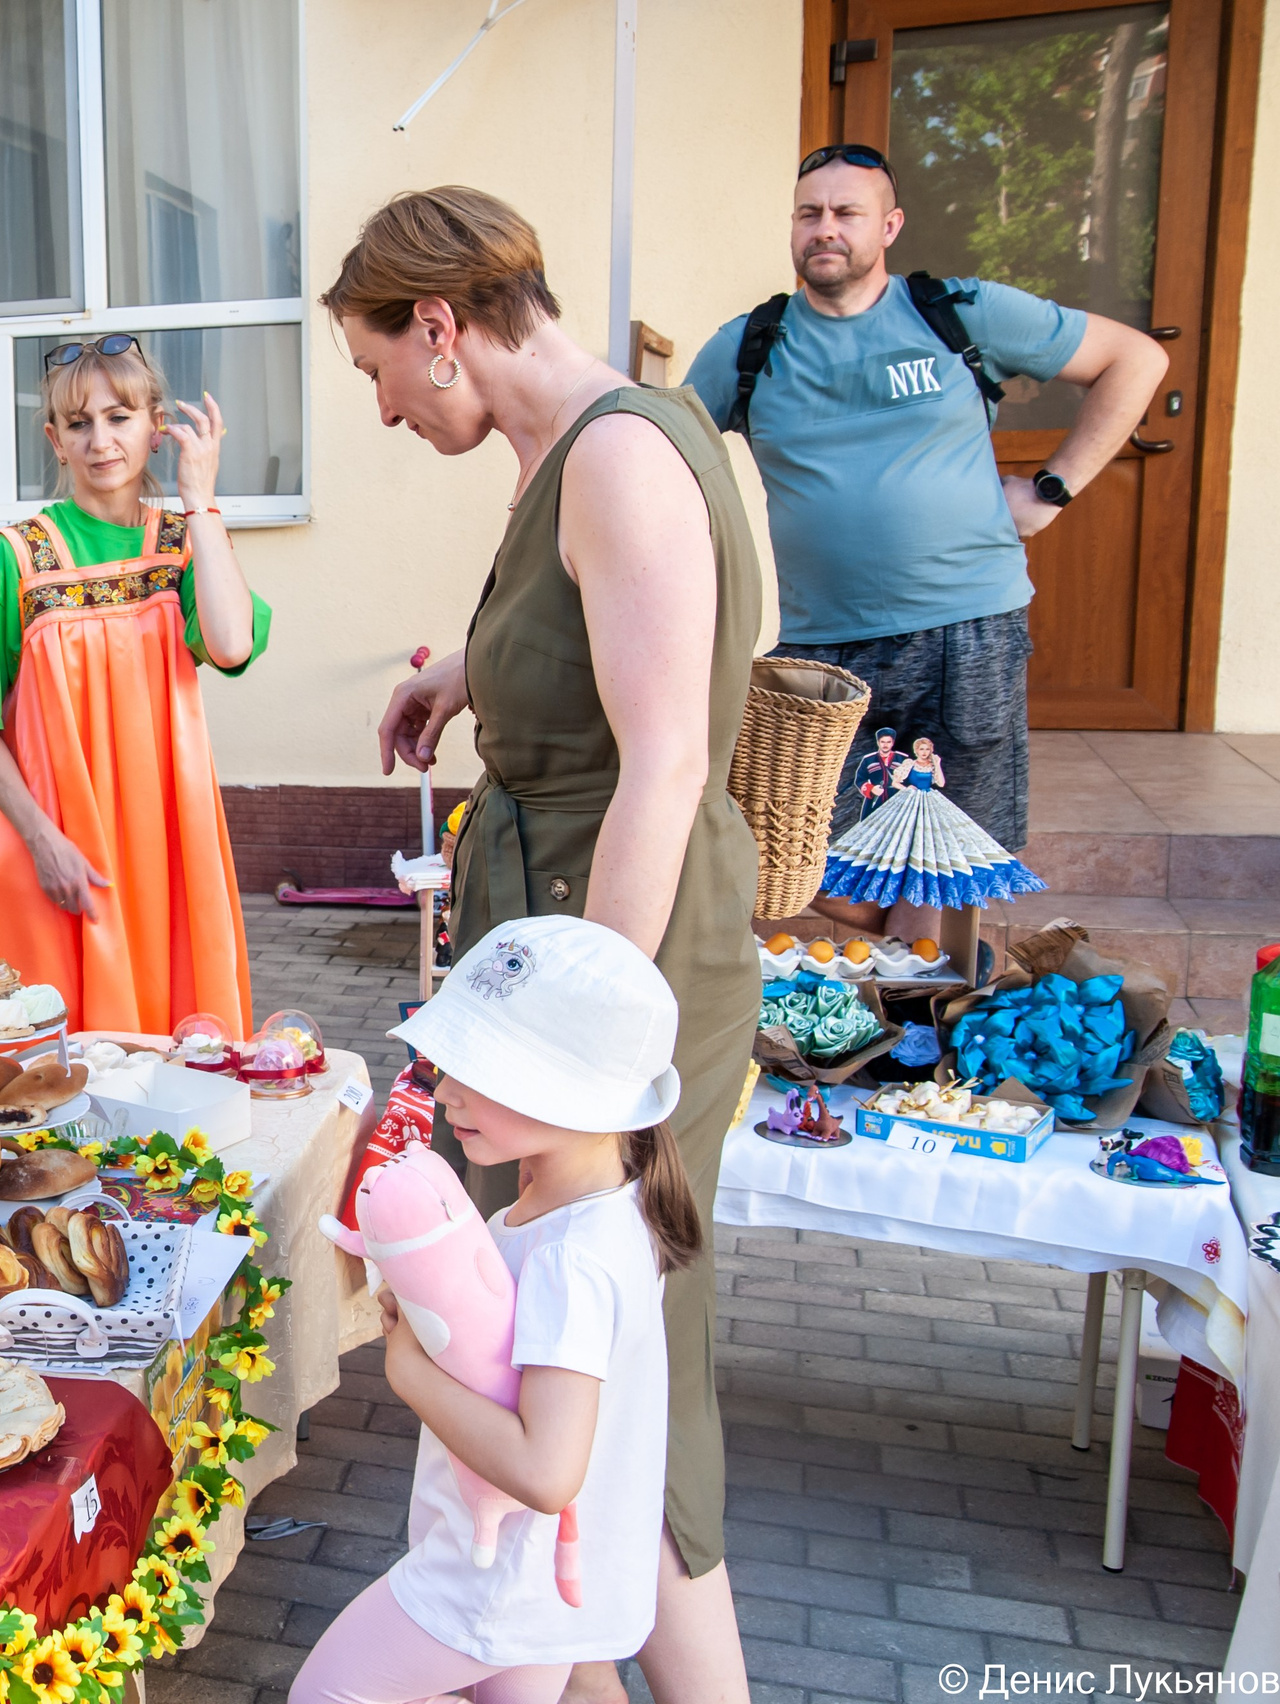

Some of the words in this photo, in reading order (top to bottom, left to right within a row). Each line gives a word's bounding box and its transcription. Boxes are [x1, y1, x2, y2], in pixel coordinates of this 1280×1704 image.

[886, 357, 942, 399] NYK
[908, 1136, 937, 1154] 10
[84, 1487, 98, 1522] 15
